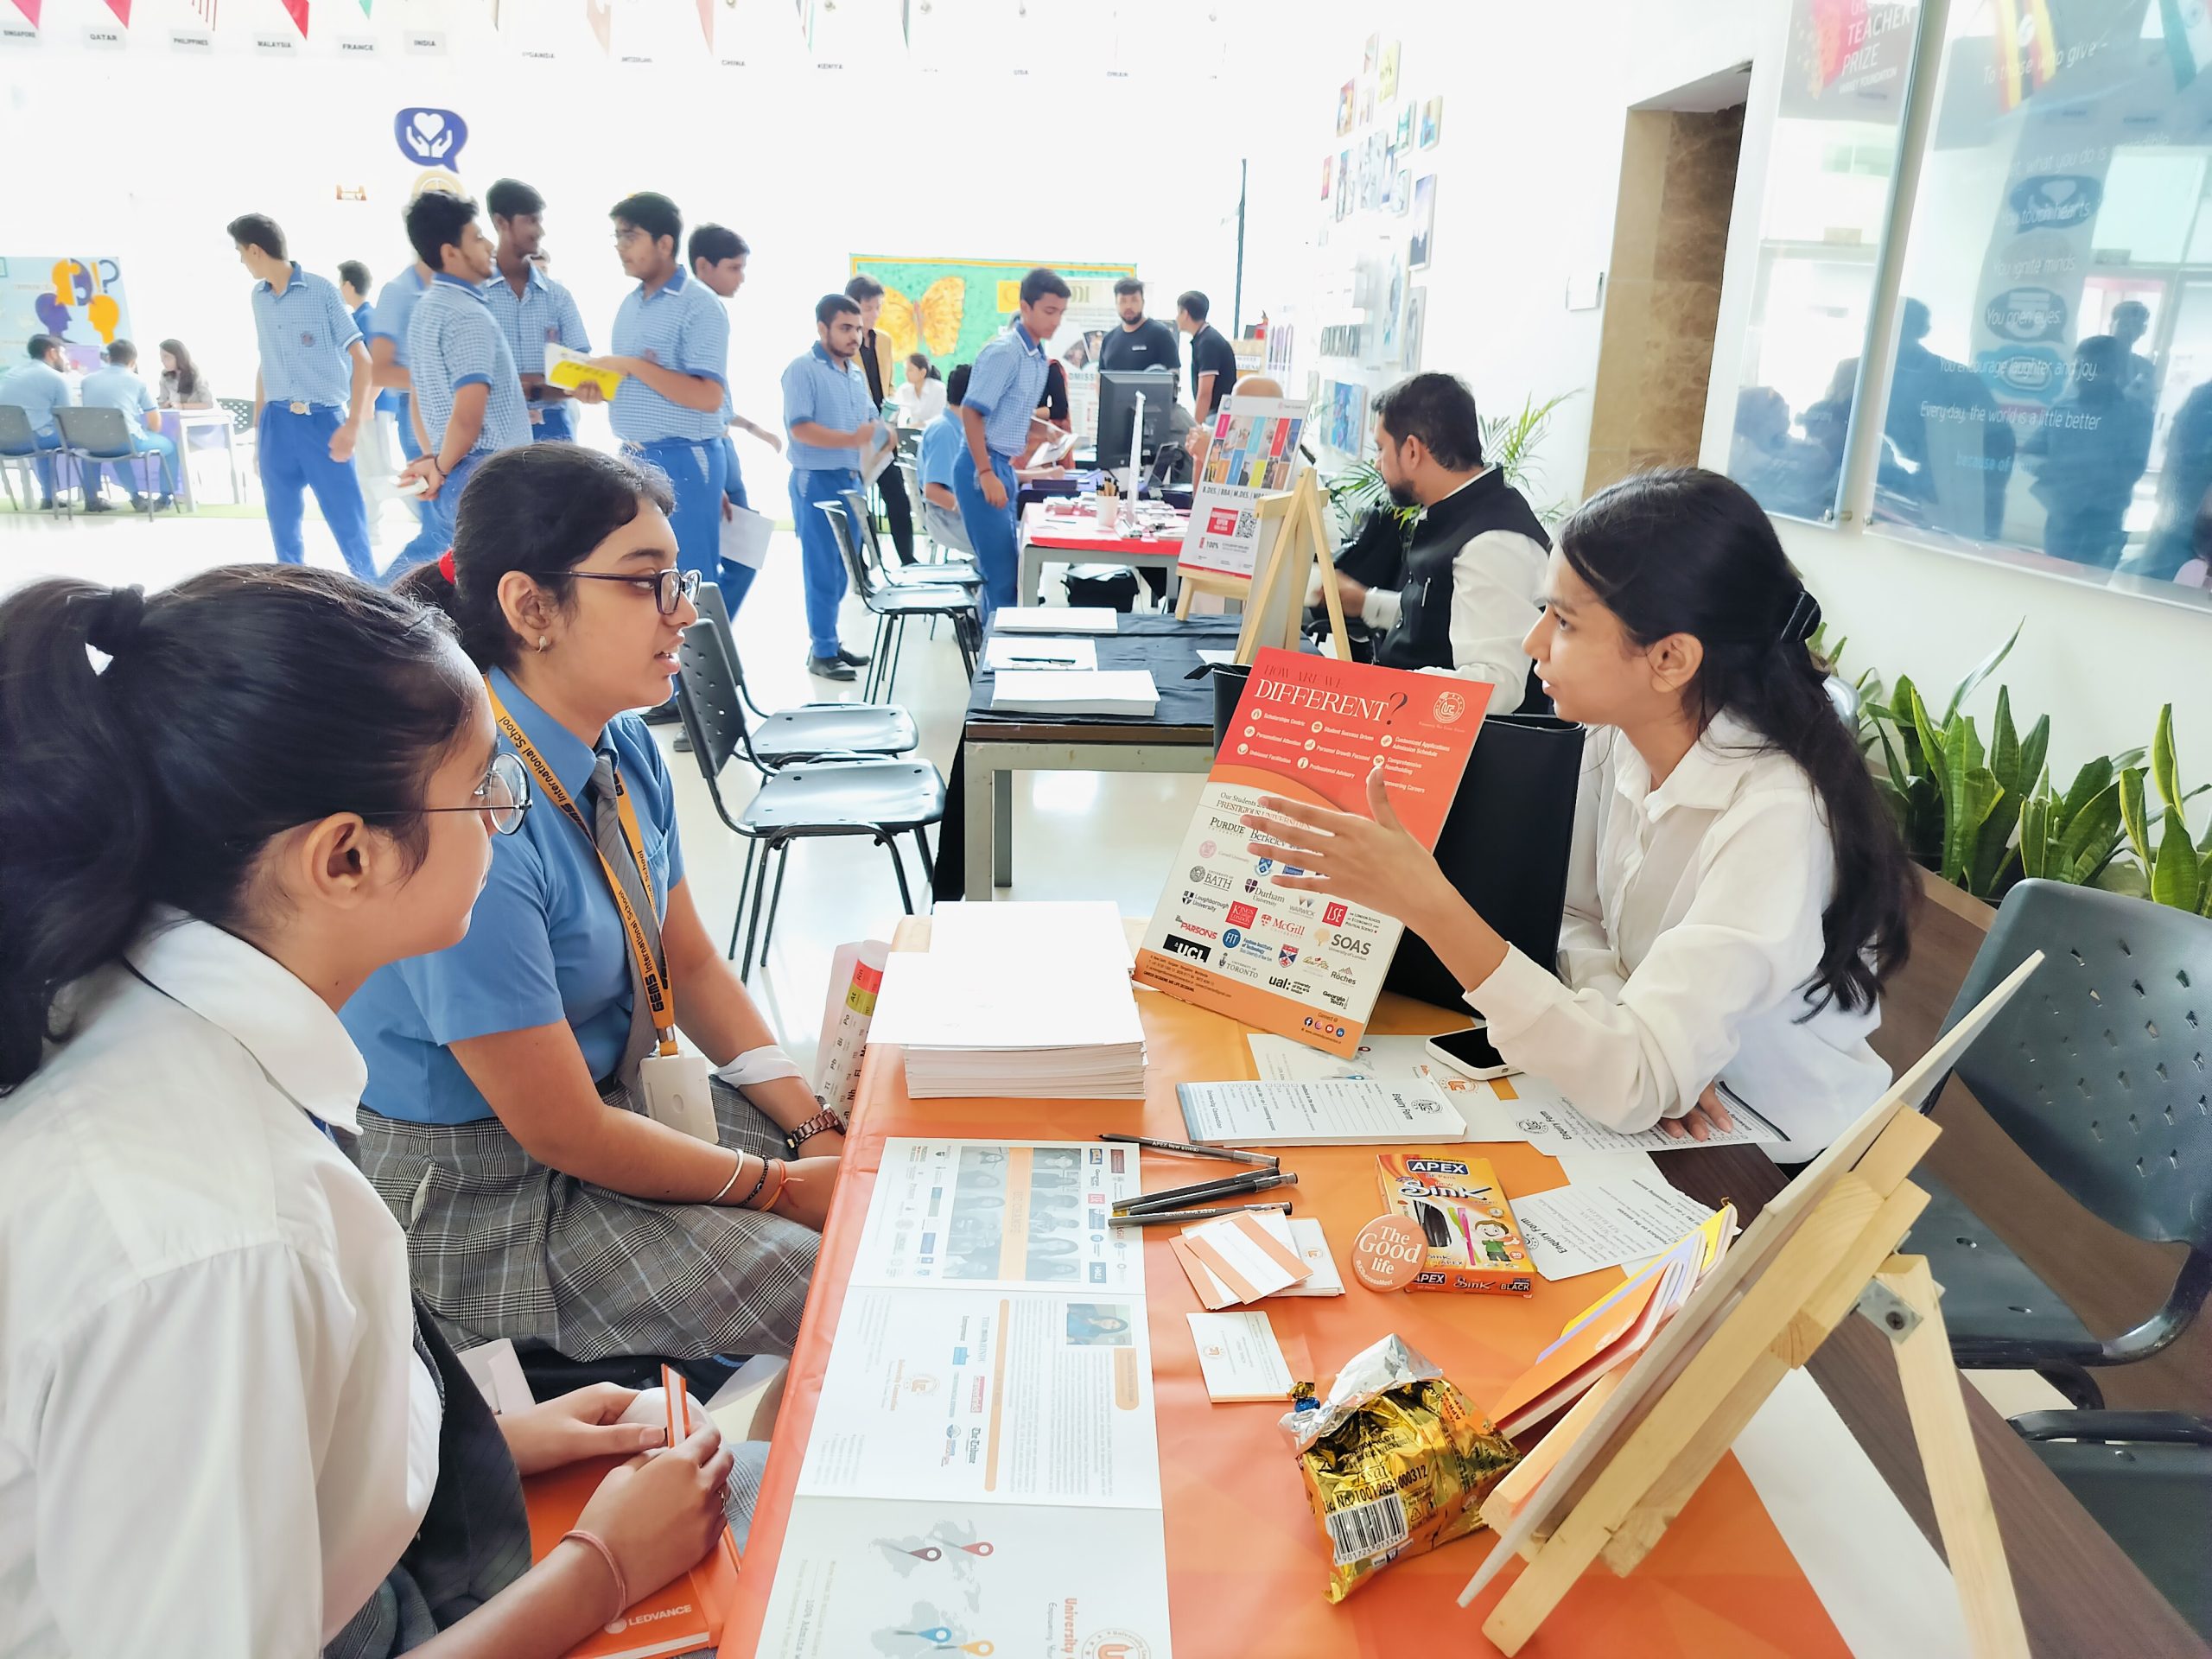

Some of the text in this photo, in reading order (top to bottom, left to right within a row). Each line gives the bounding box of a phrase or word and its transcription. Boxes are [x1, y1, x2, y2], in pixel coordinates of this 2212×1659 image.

[1847, 5, 1912, 47] TEACHER
[90, 33, 118, 42] QATAR
[173, 38, 208, 47] PHILIPPINES
[257, 41, 292, 49] MALAYSIA
[342, 43, 374, 52] FRANCE
[1841, 41, 1881, 77] PRIZE
[1984, 64, 1996, 85] To
[2067, 41, 2096, 69] give
[2056, 151, 2075, 174] you
[2079, 144, 2095, 164] do
[2097, 146, 2108, 162] is
[1986, 308, 2005, 326] You
[2005, 310, 2032, 328] open
[2008, 358, 2053, 380] laughter
[2054, 361, 2075, 377] and
[1969, 404, 2102, 430] the world is little better
[1997, 456, 2012, 472] of
[1264, 664, 1289, 678] HOW
[1324, 727, 1341, 735] Student
[1341, 730, 1359, 740] Success
[1316, 745, 1370, 762] Personal Growth Focused
[1392, 744, 1438, 757] Admission Schedule
[1421, 741, 1451, 753] Applications
[498, 715, 567, 803] International School
[1388, 757, 1422, 769] Comprehensive
[1309, 763, 1355, 779] Professional Advisory
[1407, 785, 1425, 794] Careers
[1220, 791, 1256, 807] Our Students
[1217, 799, 1261, 816] PRESTIGIOUS
[1210, 817, 1246, 835] PURDUE
[637, 849, 649, 892] School
[1205, 873, 1232, 890] BATH
[1195, 893, 1230, 908] Loughborough
[1253, 896, 1277, 907] University
[1254, 887, 1285, 903] Durham
[618, 890, 634, 920] School
[1192, 899, 1217, 912] University
[1289, 904, 1316, 917] WARWICK
[1327, 906, 1344, 923] LSE
[1180, 921, 1217, 940] PARSONS
[1272, 918, 1306, 936] McGill
[1225, 932, 1237, 944] FIT
[1331, 933, 1371, 956] SOAS
[630, 920, 654, 974] International
[1177, 943, 1207, 963] UCL
[1226, 963, 1259, 979] TORONTO
[1331, 970, 1357, 985] Roches
[1268, 976, 1291, 991] ual:
[645, 973, 664, 1013] GEMS
[1322, 990, 1345, 1002] Georgia
[1330, 997, 1344, 1007] Tech
[843, 1014, 850, 1026] Po
[1318, 1012, 1334, 1021] Connect
[830, 1058, 837, 1071] Pb
[847, 1089, 856, 1101] Nh
[1392, 1093, 1414, 1120] Enquiry Form
[1554, 1123, 1572, 1141] Enquiry
[1411, 1161, 1465, 1173] APEX
[1617, 1208, 1634, 1221] session
[1381, 1225, 1410, 1245] The
[1521, 1217, 1567, 1254] Enquiry Form
[1648, 1230, 1668, 1245] Feedback
[1359, 1232, 1423, 1263] Good
[1370, 1257, 1395, 1274] life
[1500, 1282, 1530, 1291] BLACK
[969, 1427, 982, 1464] The Tribune
[1342, 1548, 1372, 1562] 901725
[628, 1604, 692, 1626] LEDVANCE
[1064, 1596, 1077, 1654] University
